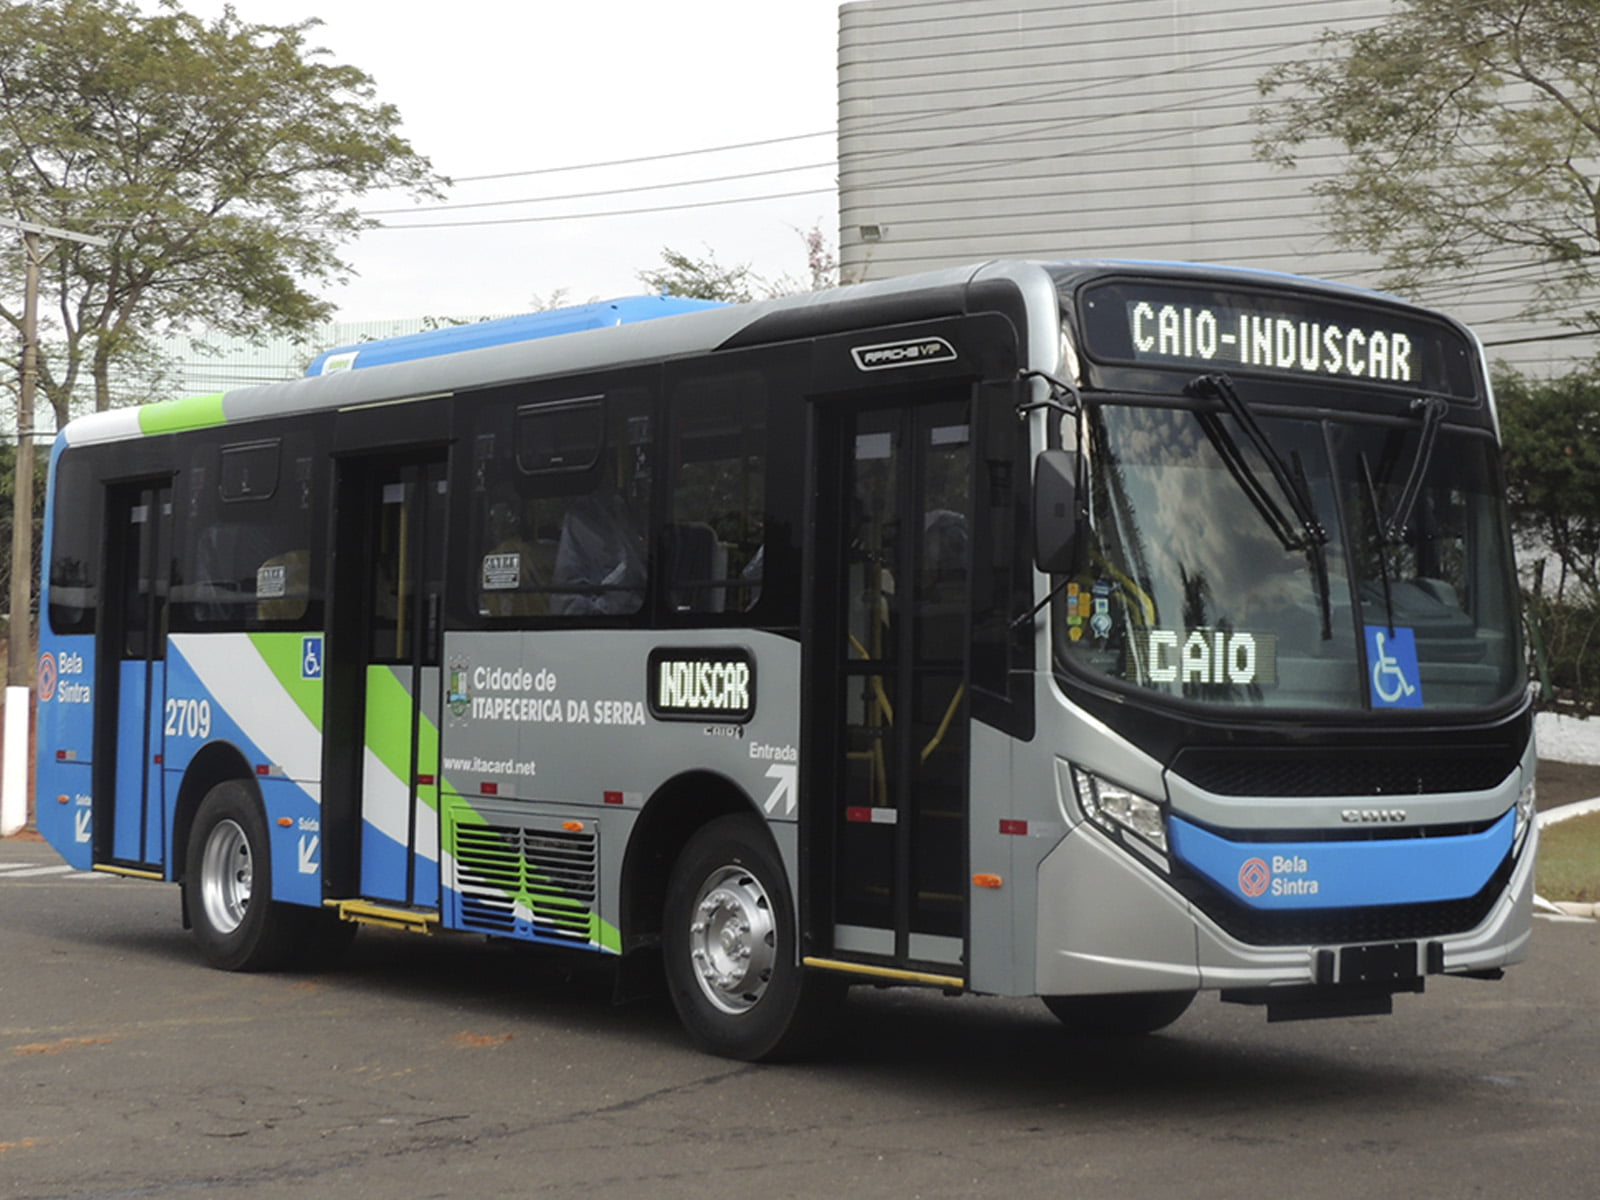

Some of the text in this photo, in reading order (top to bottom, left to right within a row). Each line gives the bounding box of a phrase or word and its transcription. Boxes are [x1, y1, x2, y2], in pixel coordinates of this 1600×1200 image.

[1133, 301, 1412, 382] CAIO-INDUSCAR
[59, 652, 83, 674] Bela
[1149, 630, 1256, 684] CAIO
[473, 666, 557, 692] Cidade de
[659, 661, 749, 709] INDUSCAR
[58, 680, 91, 703] Sintra
[165, 699, 211, 738] 2709
[472, 697, 646, 725] ITAPECERICA DA SERRA
[749, 742, 797, 761] Entrada
[443, 756, 536, 776] www.itacard.net
[1272, 856, 1307, 873] Bela
[1271, 878, 1319, 896] Sintra
